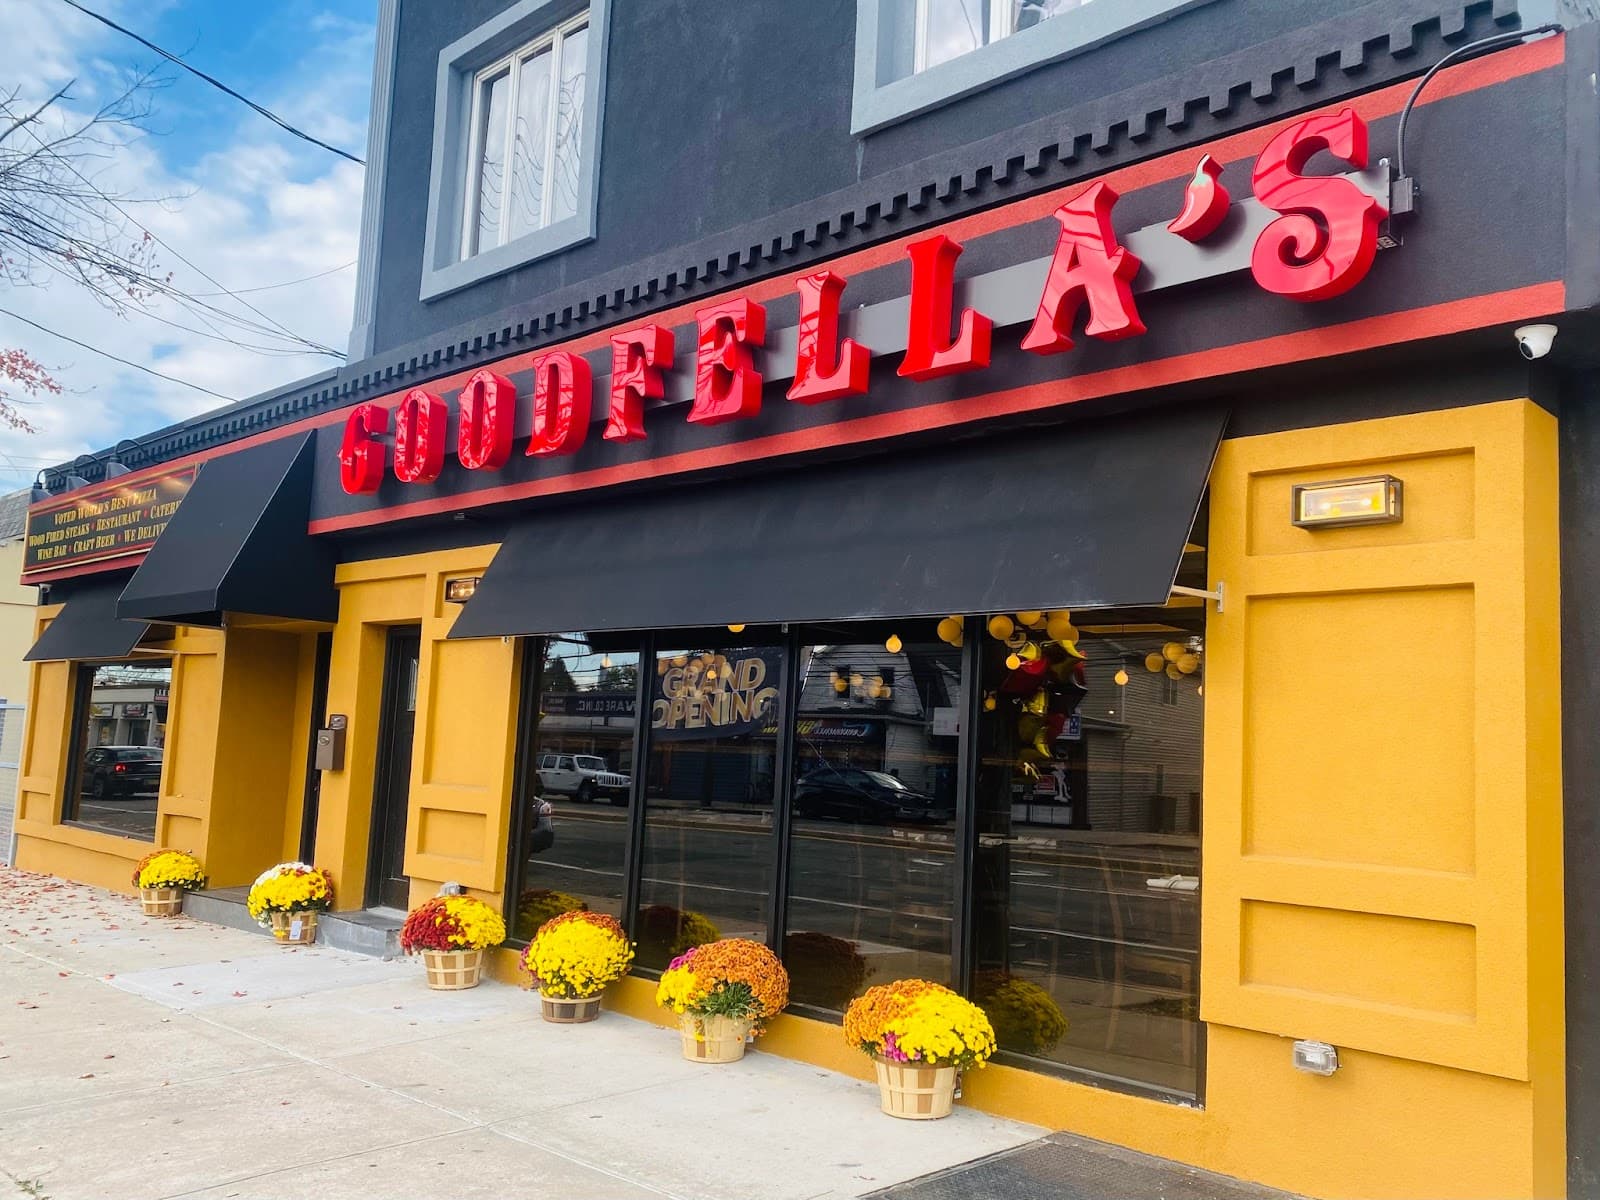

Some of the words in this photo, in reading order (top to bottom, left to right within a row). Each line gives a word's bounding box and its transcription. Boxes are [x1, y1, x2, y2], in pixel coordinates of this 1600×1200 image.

[338, 107, 1389, 496] GOODFELLA'S
[46, 529, 65, 544] FIRED
[65, 523, 90, 539] STEAKS
[96, 510, 142, 532] RESTAURANT
[54, 510, 77, 526] VOTED
[78, 501, 110, 520] WORLD'S
[111, 496, 131, 512] BEST
[131, 488, 157, 505] PIZZA
[37, 547, 54, 561] WINE
[54, 544, 67, 558] BAR
[73, 538, 95, 554] CRAFT
[95, 533, 116, 549] BEER
[124, 529, 137, 543] WE
[662, 657, 767, 699] GRAND
[652, 687, 780, 730] OPENING
